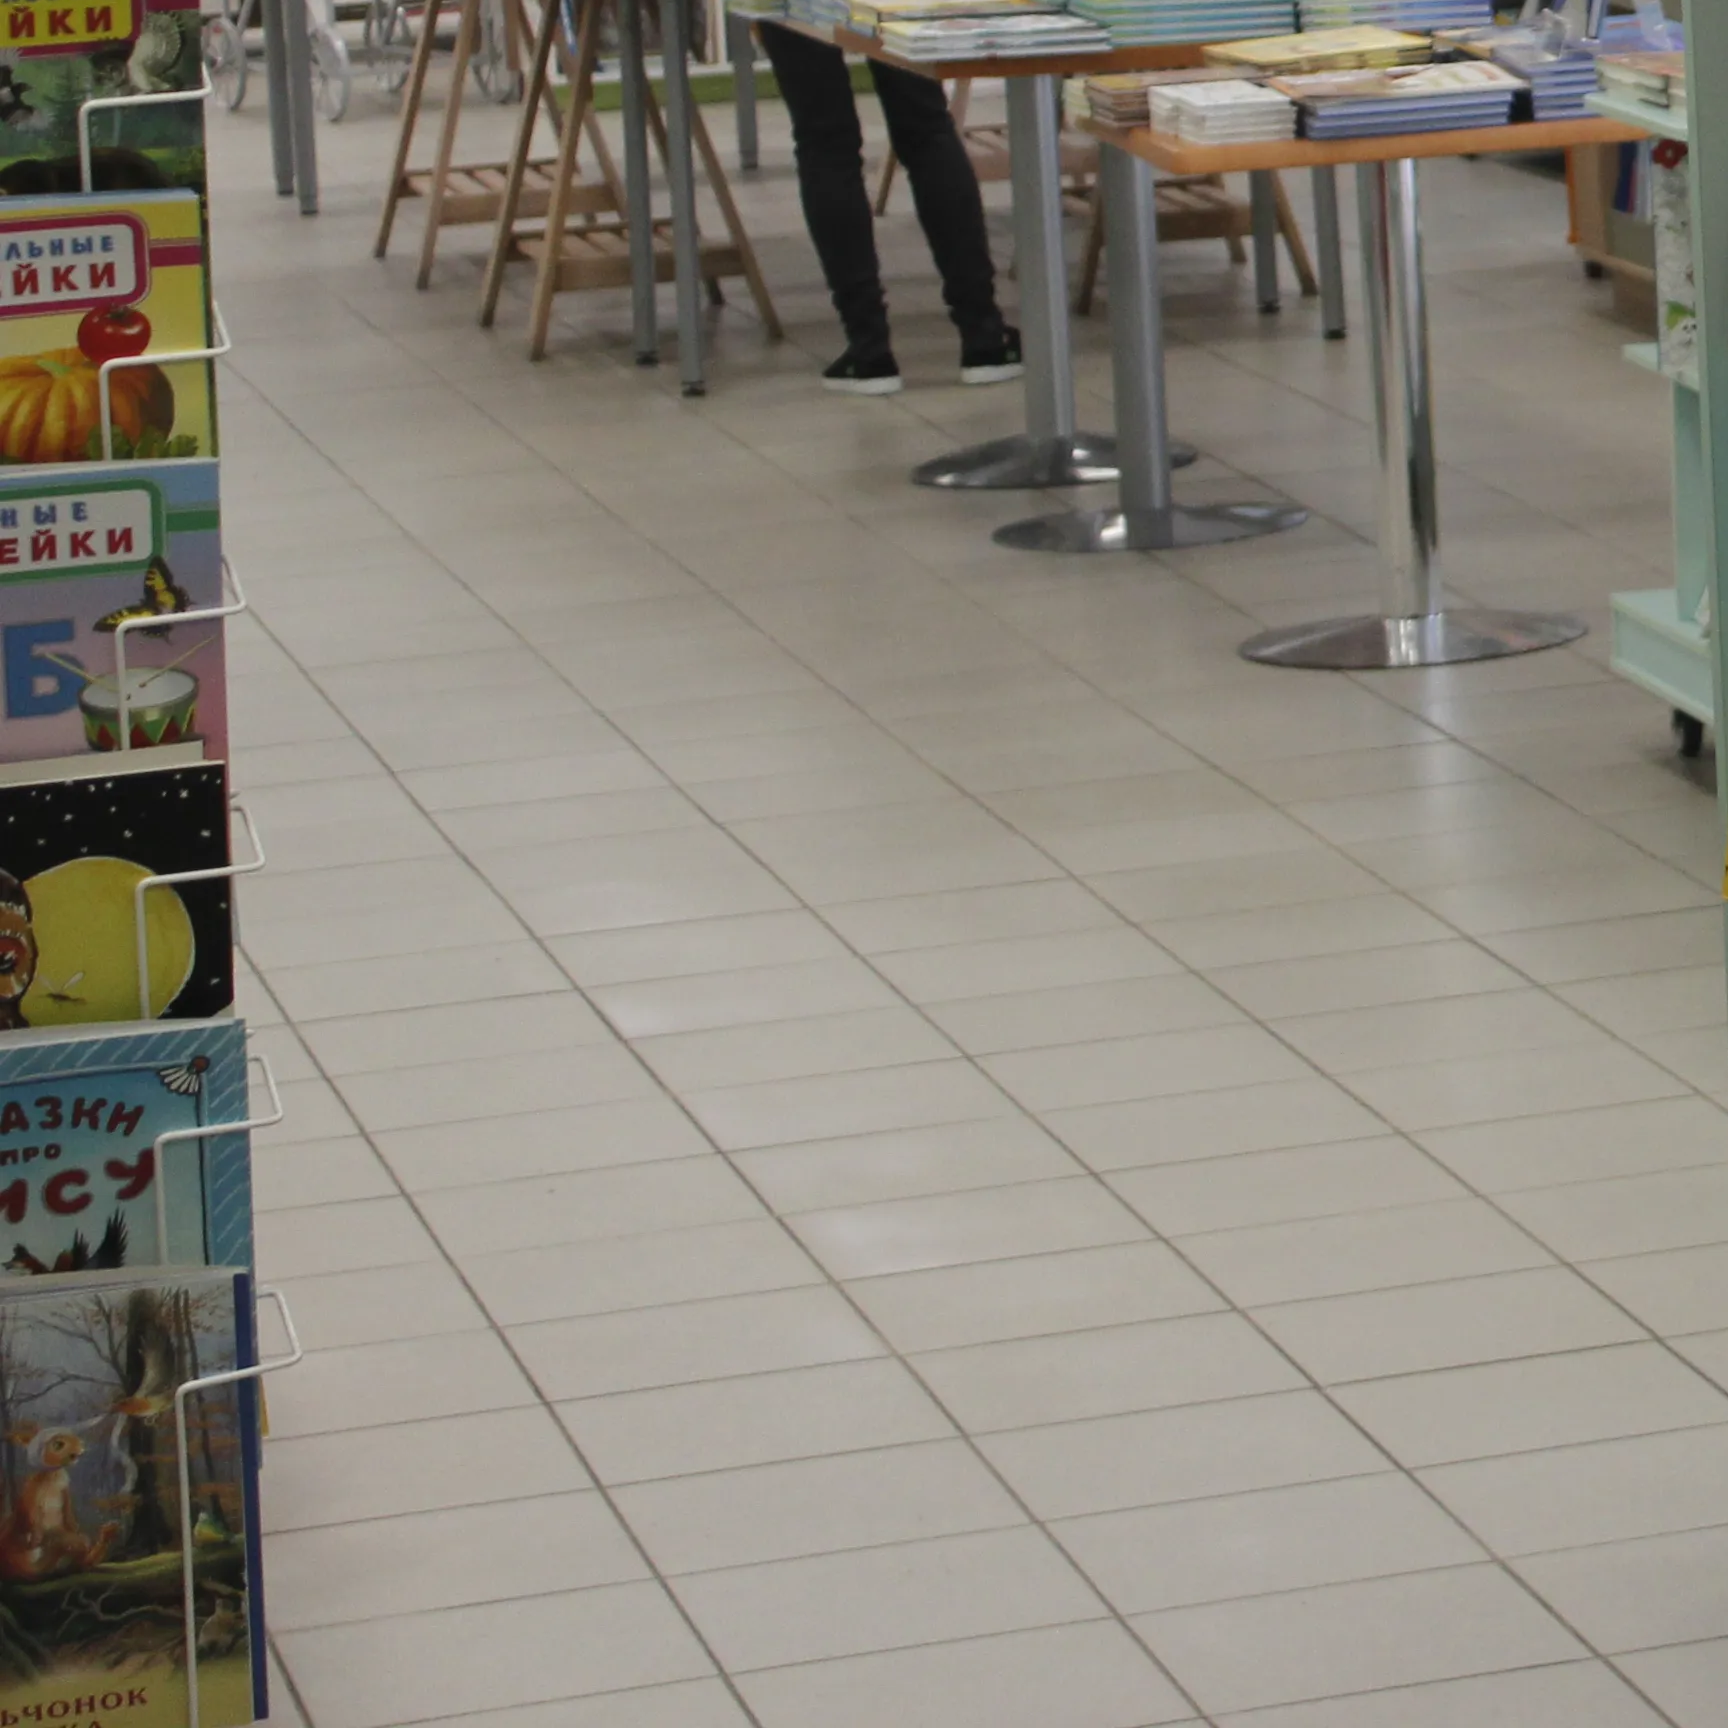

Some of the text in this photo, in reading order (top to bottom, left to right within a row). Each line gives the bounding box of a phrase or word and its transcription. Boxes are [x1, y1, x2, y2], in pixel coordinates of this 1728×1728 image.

[8, 5, 113, 40] ЙКИ
[4, 235, 115, 261] ЛЬНЫЕ
[12, 261, 117, 297] ЙКИ
[0, 526, 133, 566] ЕЙКИ
[3, 617, 86, 720] Б
[0, 1095, 145, 1137] АЗКИ
[0, 1686, 149, 1728] ЬЧОНОК
